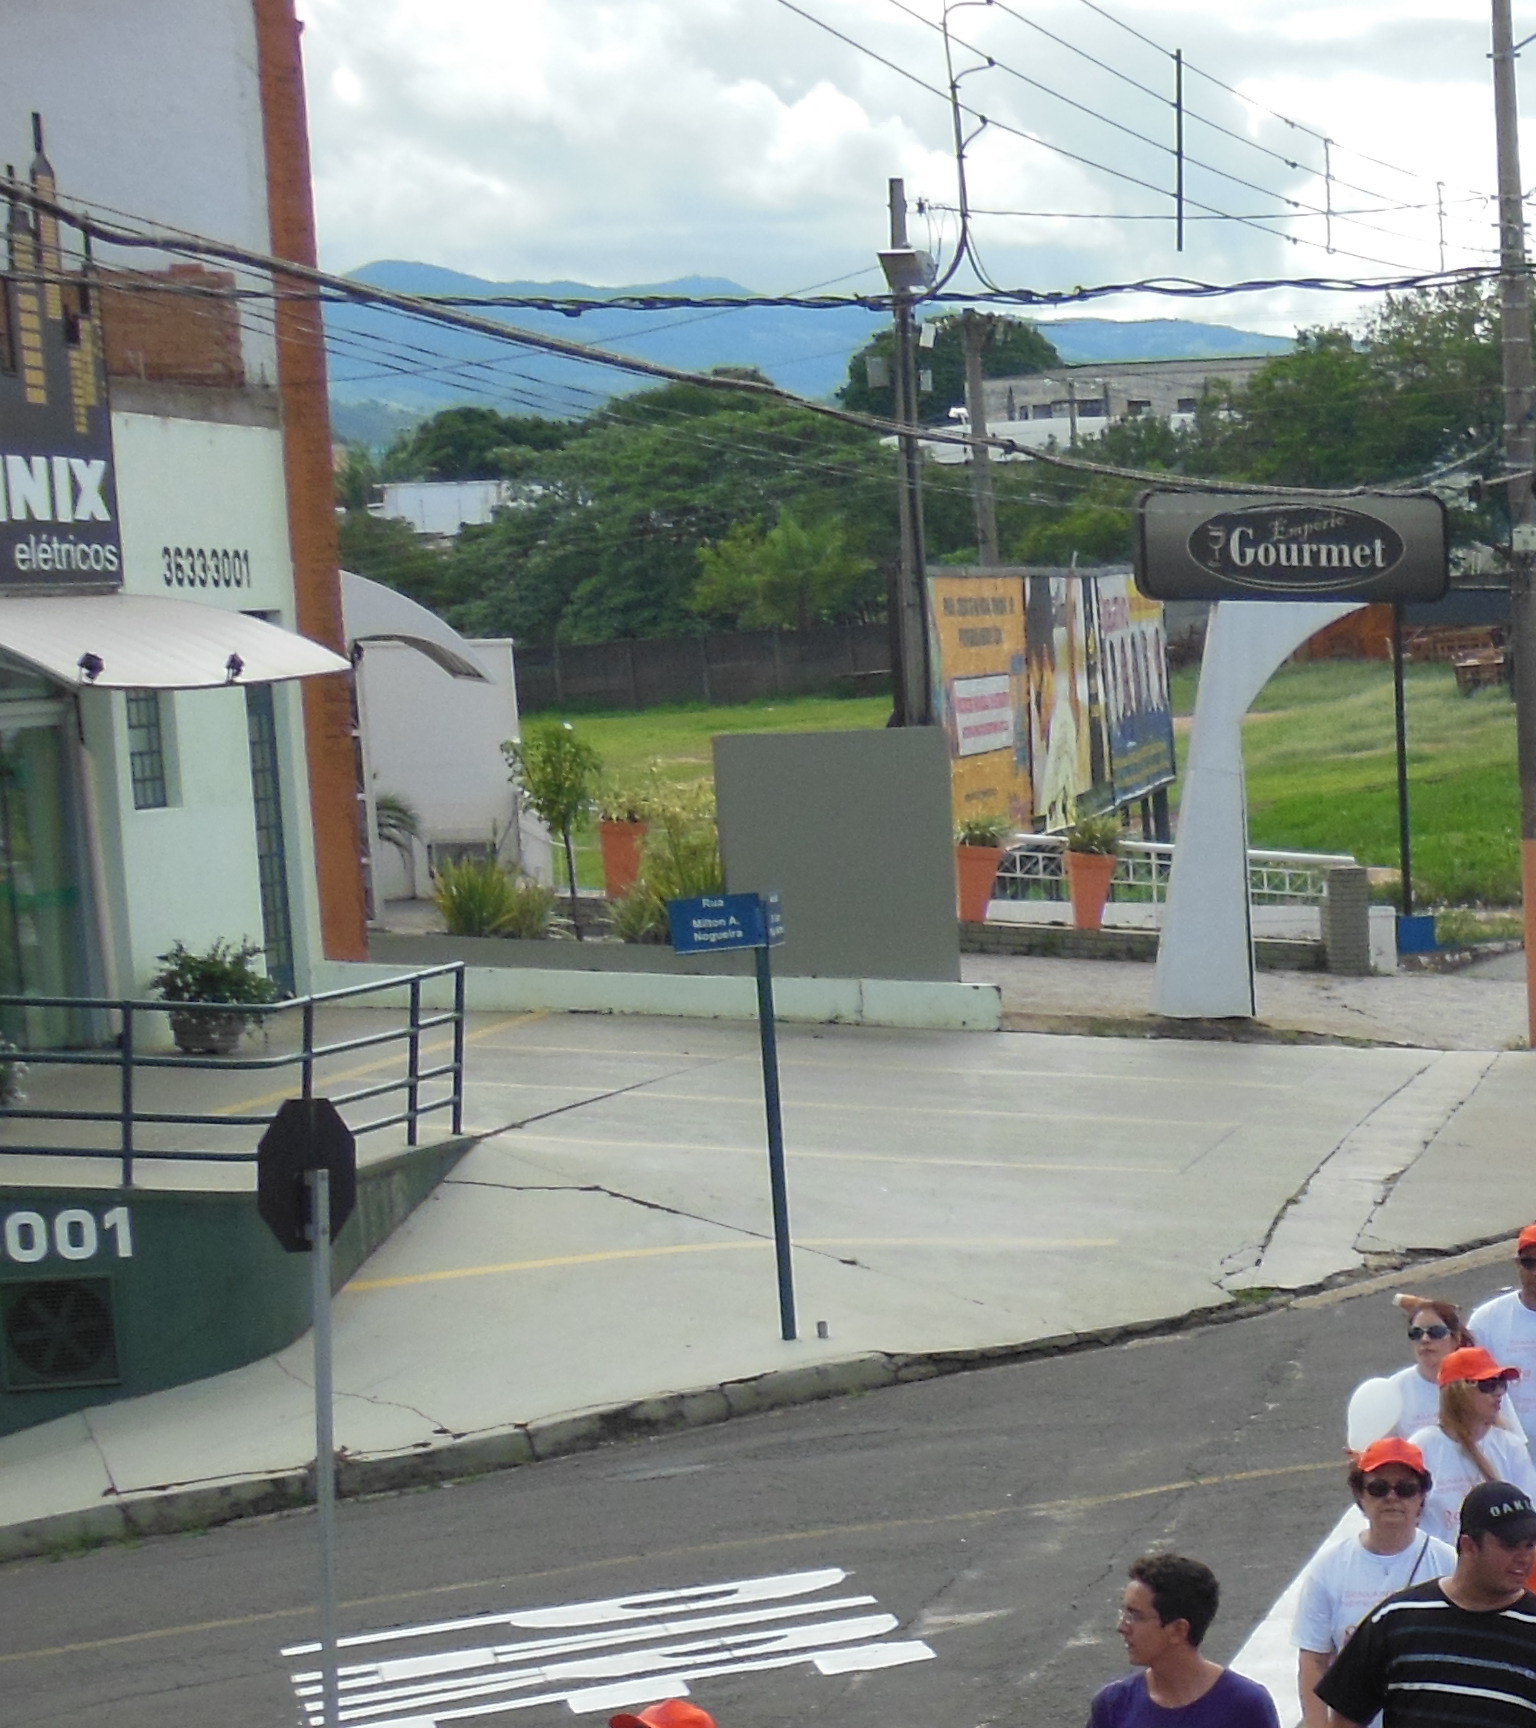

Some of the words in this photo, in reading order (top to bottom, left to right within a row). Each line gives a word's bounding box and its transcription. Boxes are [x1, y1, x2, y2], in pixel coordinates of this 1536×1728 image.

[0, 454, 111, 523] NIX
[15, 533, 118, 571] elétricos
[1230, 527, 1386, 568] Gourmet
[702, 898, 724, 908] Rua
[5, 1206, 133, 1263] 001
[1489, 1499, 1534, 1517] OAKL
